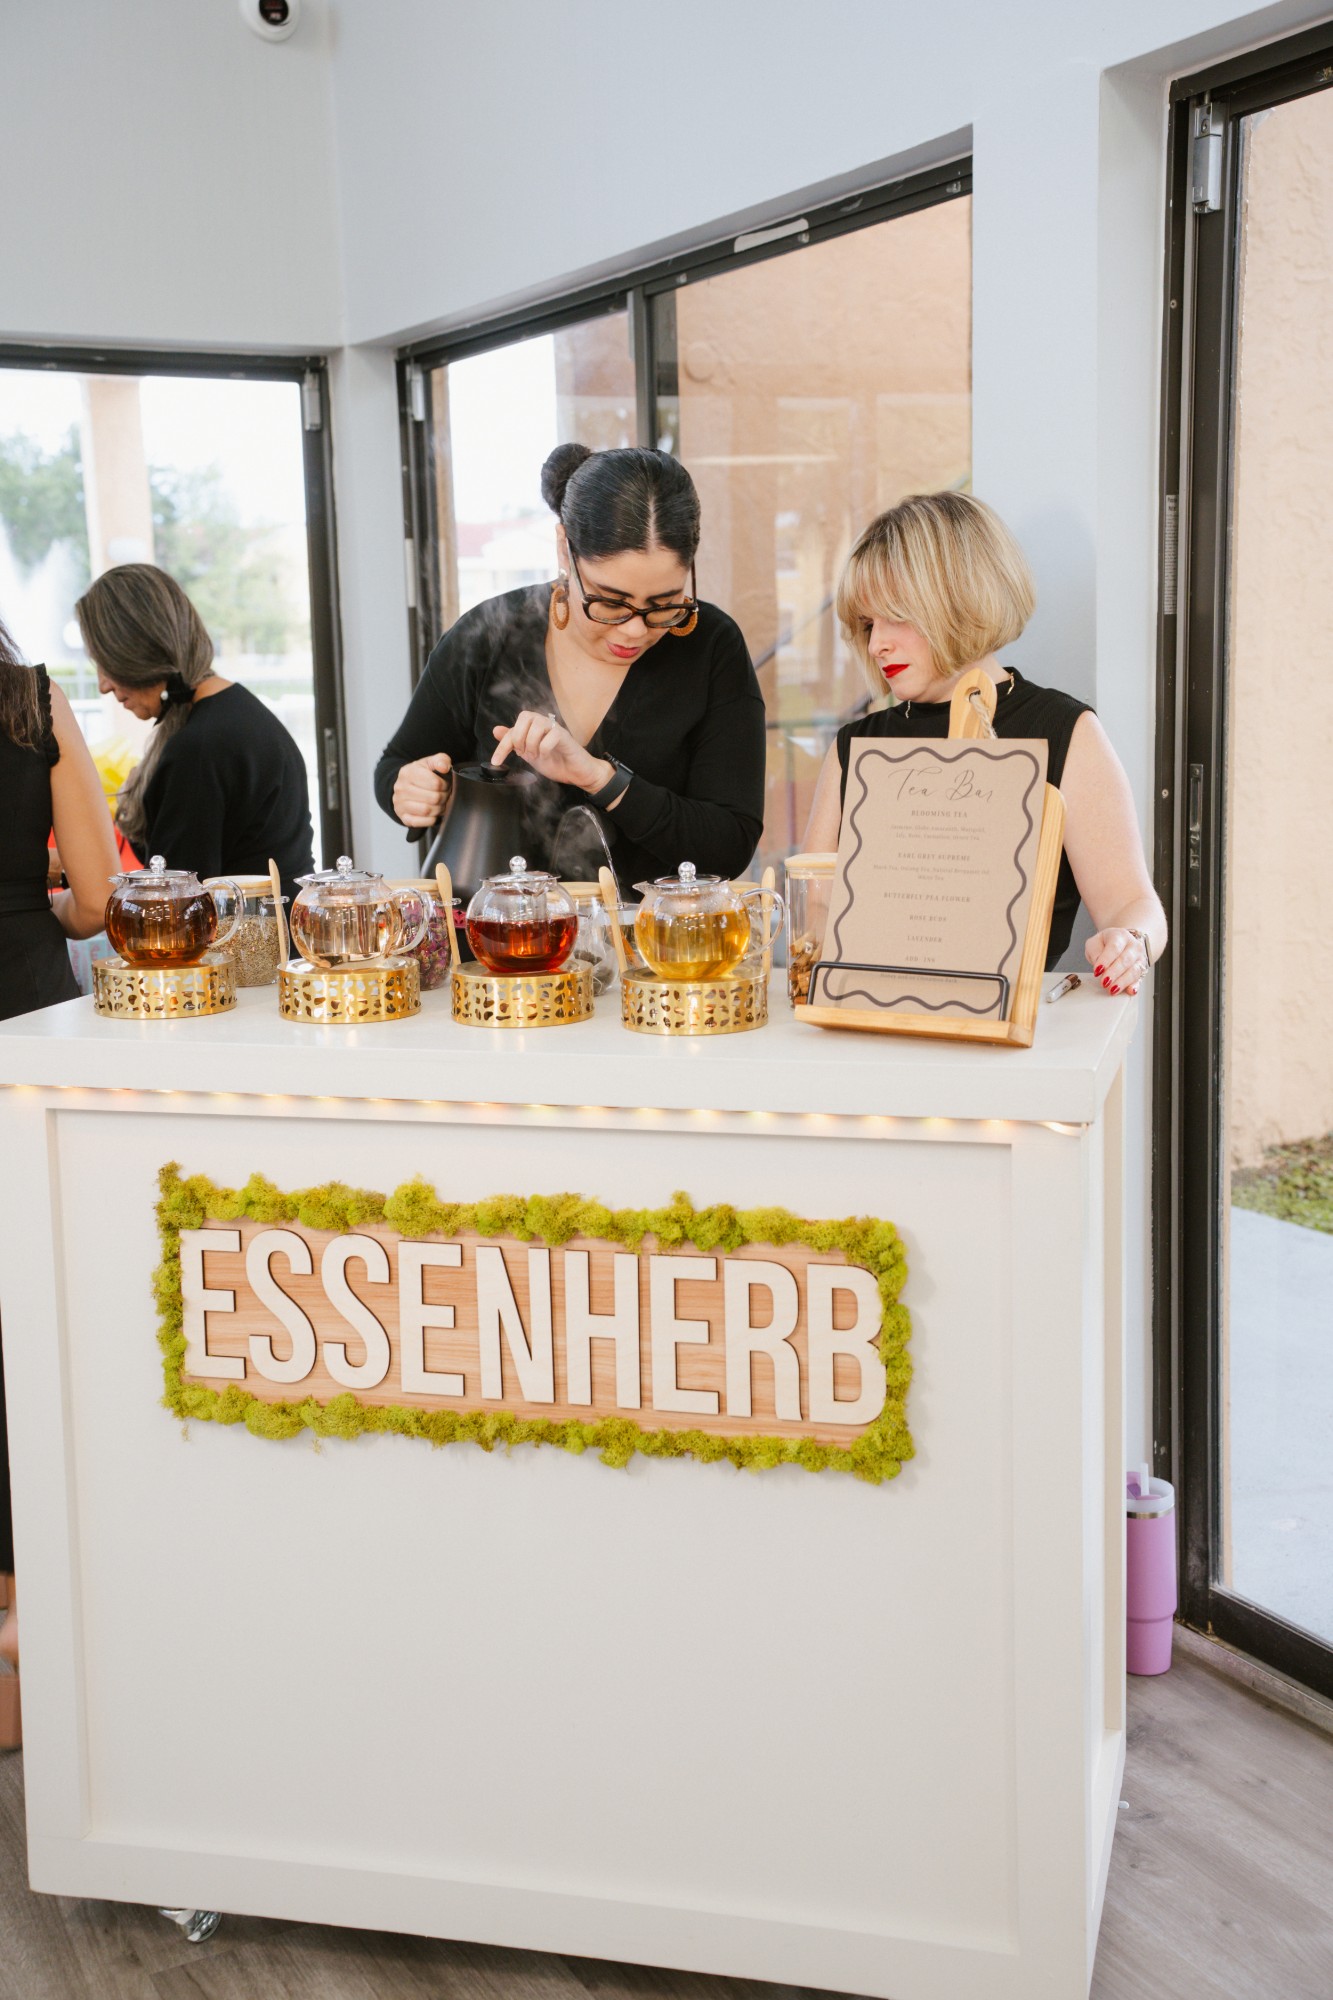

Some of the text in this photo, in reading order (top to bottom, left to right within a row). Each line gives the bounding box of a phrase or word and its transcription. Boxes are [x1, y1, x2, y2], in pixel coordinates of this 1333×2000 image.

[888, 766, 993, 802] Tea Bar
[911, 810, 968, 819] BLOOMING TEA
[938, 854, 971, 862] SUPREME
[883, 892, 971, 903] BUTTERFLY PEA FLOWER
[907, 935, 943, 943] LAVENDER
[180, 1228, 885, 1425] ESSENHERB
